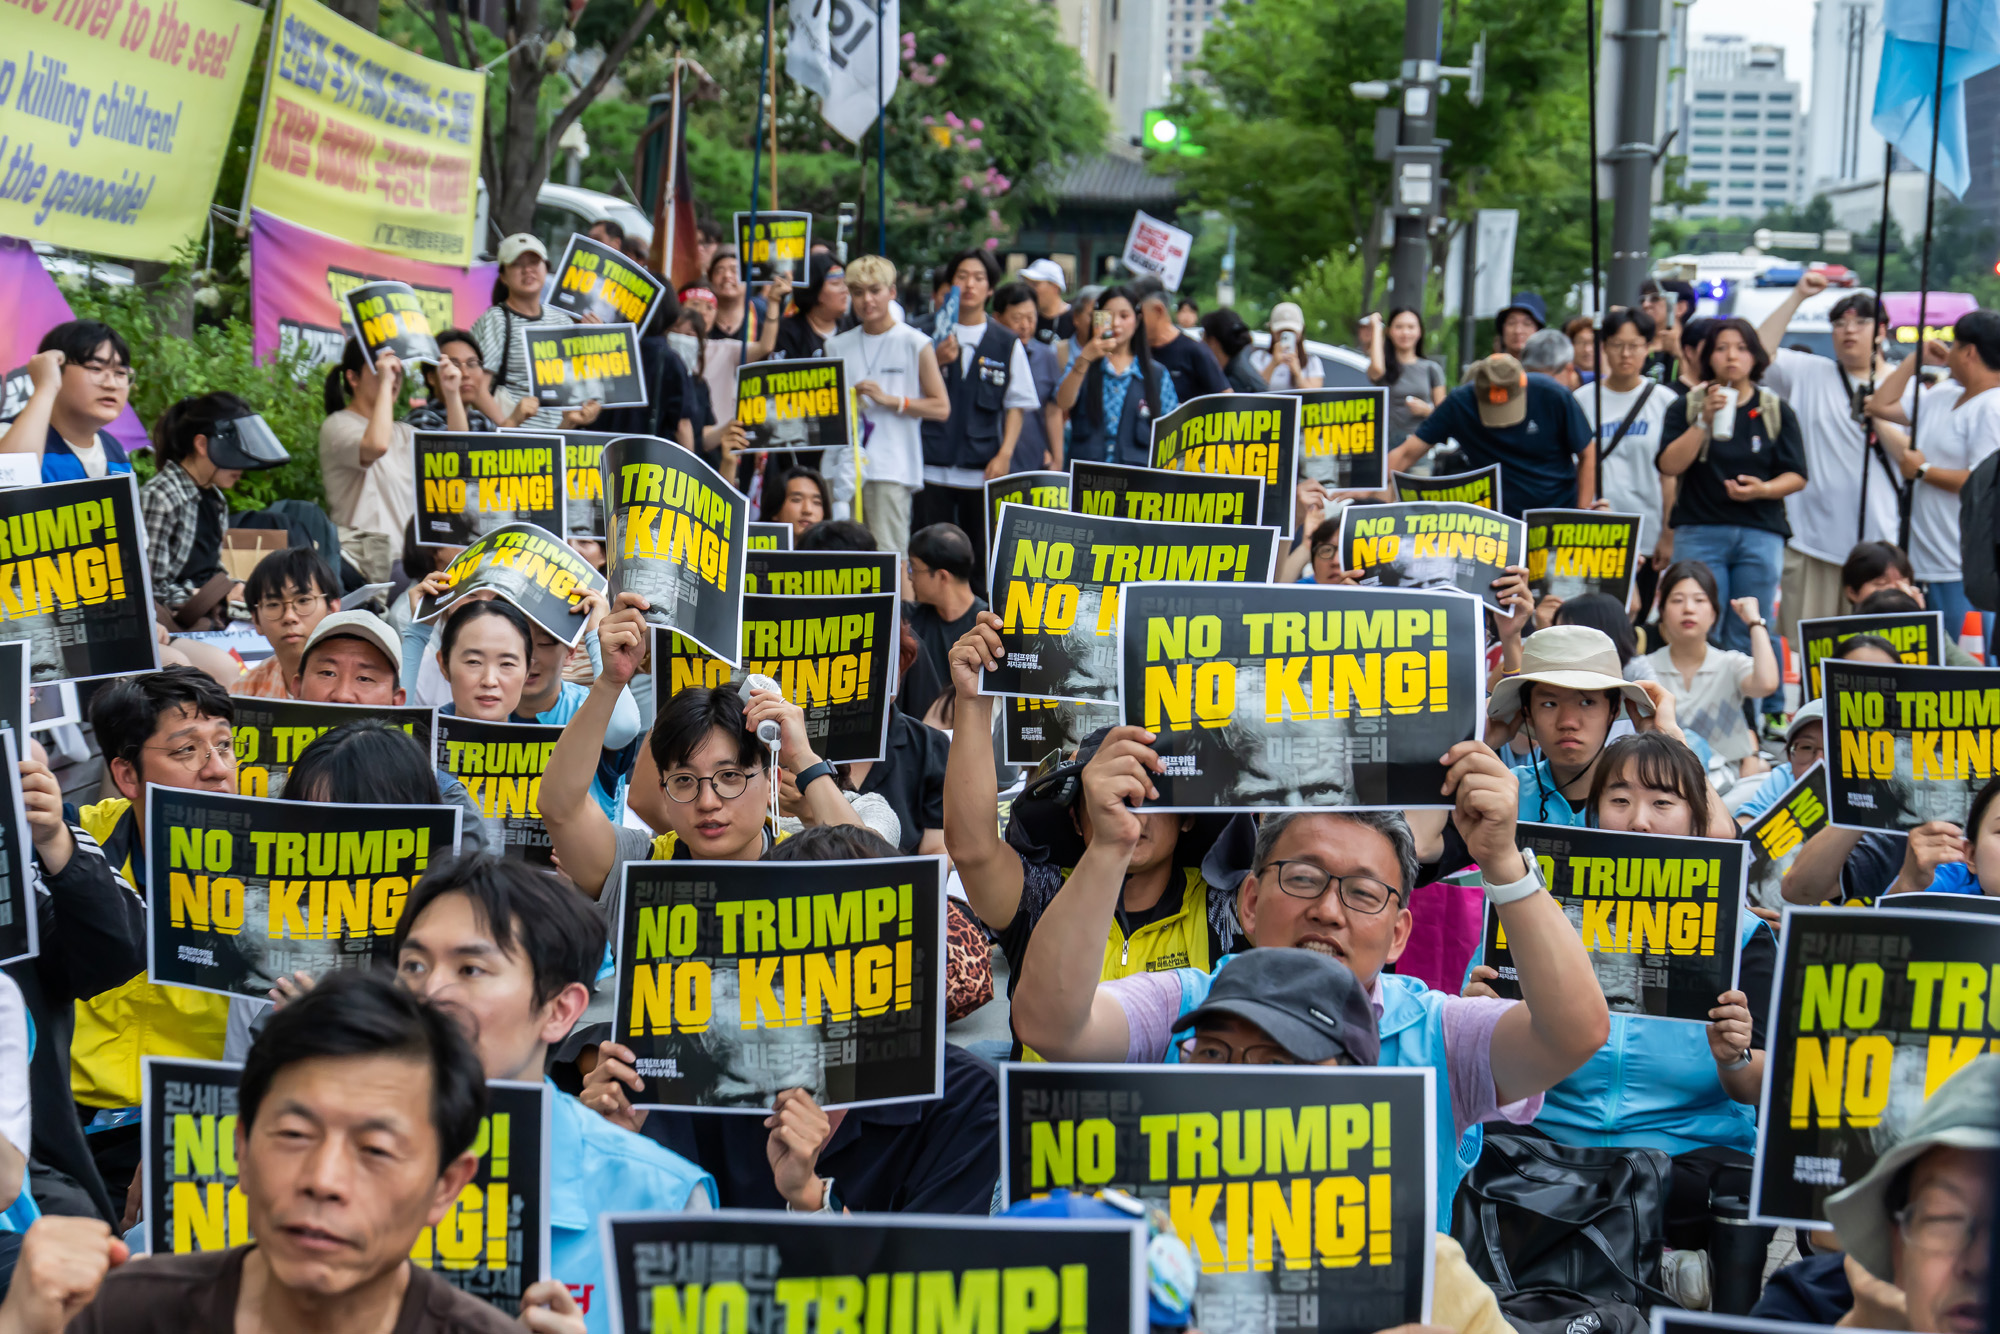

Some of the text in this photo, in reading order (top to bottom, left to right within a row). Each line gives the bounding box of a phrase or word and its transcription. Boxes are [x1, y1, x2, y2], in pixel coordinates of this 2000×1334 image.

[119, 0, 151, 52] to
[149, 0, 190, 66] the
[188, 23, 240, 79] sea!
[16, 50, 91, 148] killing
[92, 80, 183, 154] children!
[0, 142, 48, 205] the
[34, 168, 156, 227] genocide!
[562, 266, 647, 324] NO KING!
[571, 249, 599, 270] NO
[603, 260, 654, 304] TRUMP!
[356, 297, 386, 321] NO
[363, 313, 397, 346] NO
[533, 333, 627, 360] NO TRUMP!
[535, 350, 631, 385] NO KING!
[737, 387, 839, 426] NO KING!
[740, 367, 837, 400] NO TRUMP!
[1157, 410, 1281, 464] NO TRUMP!
[1304, 421, 1374, 457] KING!
[424, 448, 552, 478] NO TRUMP!
[566, 468, 604, 500] KIN
[1184, 443, 1279, 485] KING!
[424, 475, 554, 514] NO KING!
[621, 463, 732, 540] TRUMP!
[1082, 490, 1244, 524] NO TRUMP!
[1422, 476, 1490, 503] TRUMP!
[624, 506, 729, 592] KING!
[1352, 536, 1400, 570] NO
[1415, 532, 1507, 568] KING!
[1355, 514, 1507, 539] NO TRUMP!
[1552, 524, 1631, 547] TRUMP!
[489, 546, 589, 605] KING!
[494, 531, 594, 583] TRUMP!
[768, 567, 880, 595] TRUMP!
[1012, 539, 1249, 582] NO TRUMP!
[1555, 547, 1627, 578] KING!
[1003, 580, 1079, 635] NO
[1147, 615, 1221, 661] NO
[1243, 610, 1447, 655] TRUMP!
[1809, 637, 1833, 664] NO
[1145, 650, 1448, 733] NO KING!
[1839, 688, 2000, 728] NO TRUM
[446, 741, 556, 773] TRUMP
[1840, 730, 1894, 780] NO
[1788, 787, 1825, 828] NO
[170, 826, 430, 876] NO TRUMP!
[1756, 808, 1804, 860] NO
[1569, 857, 1721, 898] TRUMP!
[170, 872, 245, 935] NO
[636, 884, 912, 959] NO TRUMP!
[1582, 900, 1718, 956] KING!
[630, 940, 912, 1036] NO KING!
[1799, 962, 1885, 1031] NO
[1790, 1035, 1894, 1129] NO
[1031, 1102, 1391, 1187] NO TRUMP!
[1169, 1174, 1392, 1274] KING!
[652, 1283, 748, 1334] NO
[775, 1263, 1087, 1334] TRUMP!
